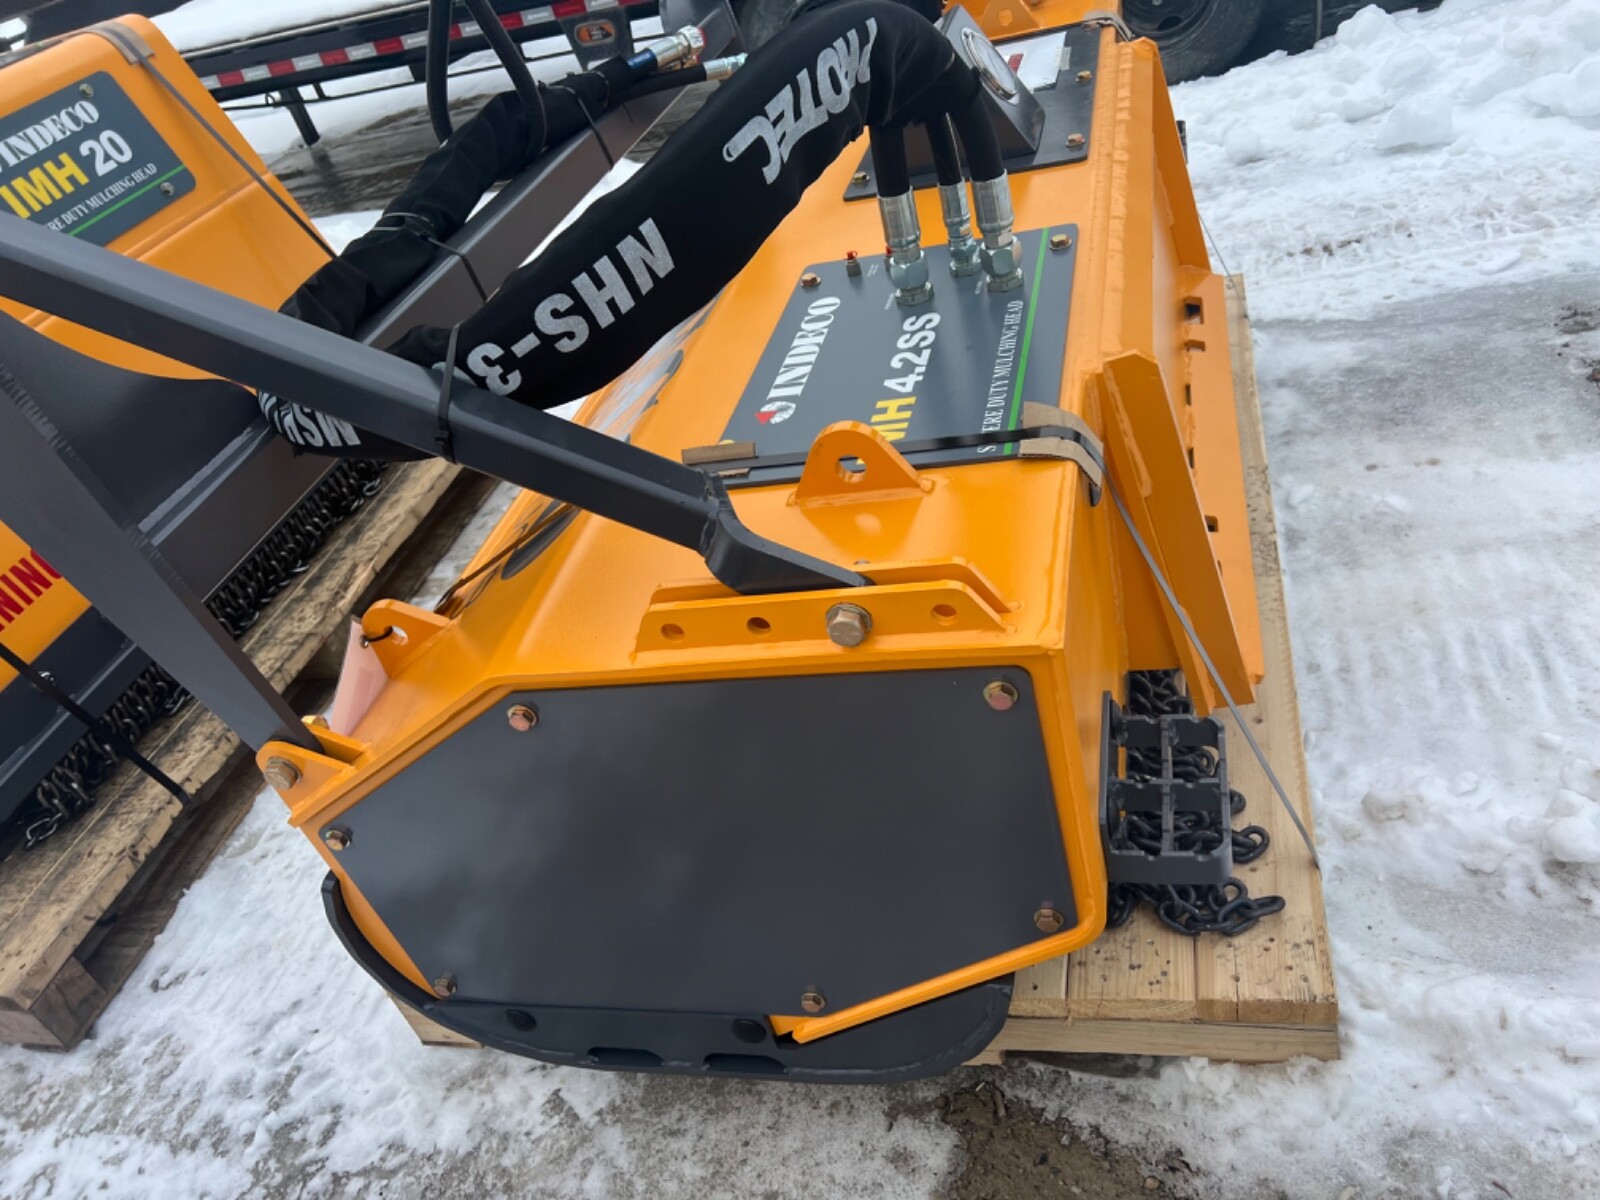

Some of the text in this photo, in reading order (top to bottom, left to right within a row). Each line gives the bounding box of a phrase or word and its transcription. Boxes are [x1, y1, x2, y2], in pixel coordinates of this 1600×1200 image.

[0, 130, 132, 220] IMH 20
[1, 101, 99, 167] INDECO
[61, 162, 158, 225] DUTY MULCHING HEAD
[432, 217, 675, 396] NHS-3
[767, 296, 841, 400] INDECO
[883, 312, 941, 393] 4.2SS
[977, 299, 1024, 453] SERE DUTY MULCHING HEAD
